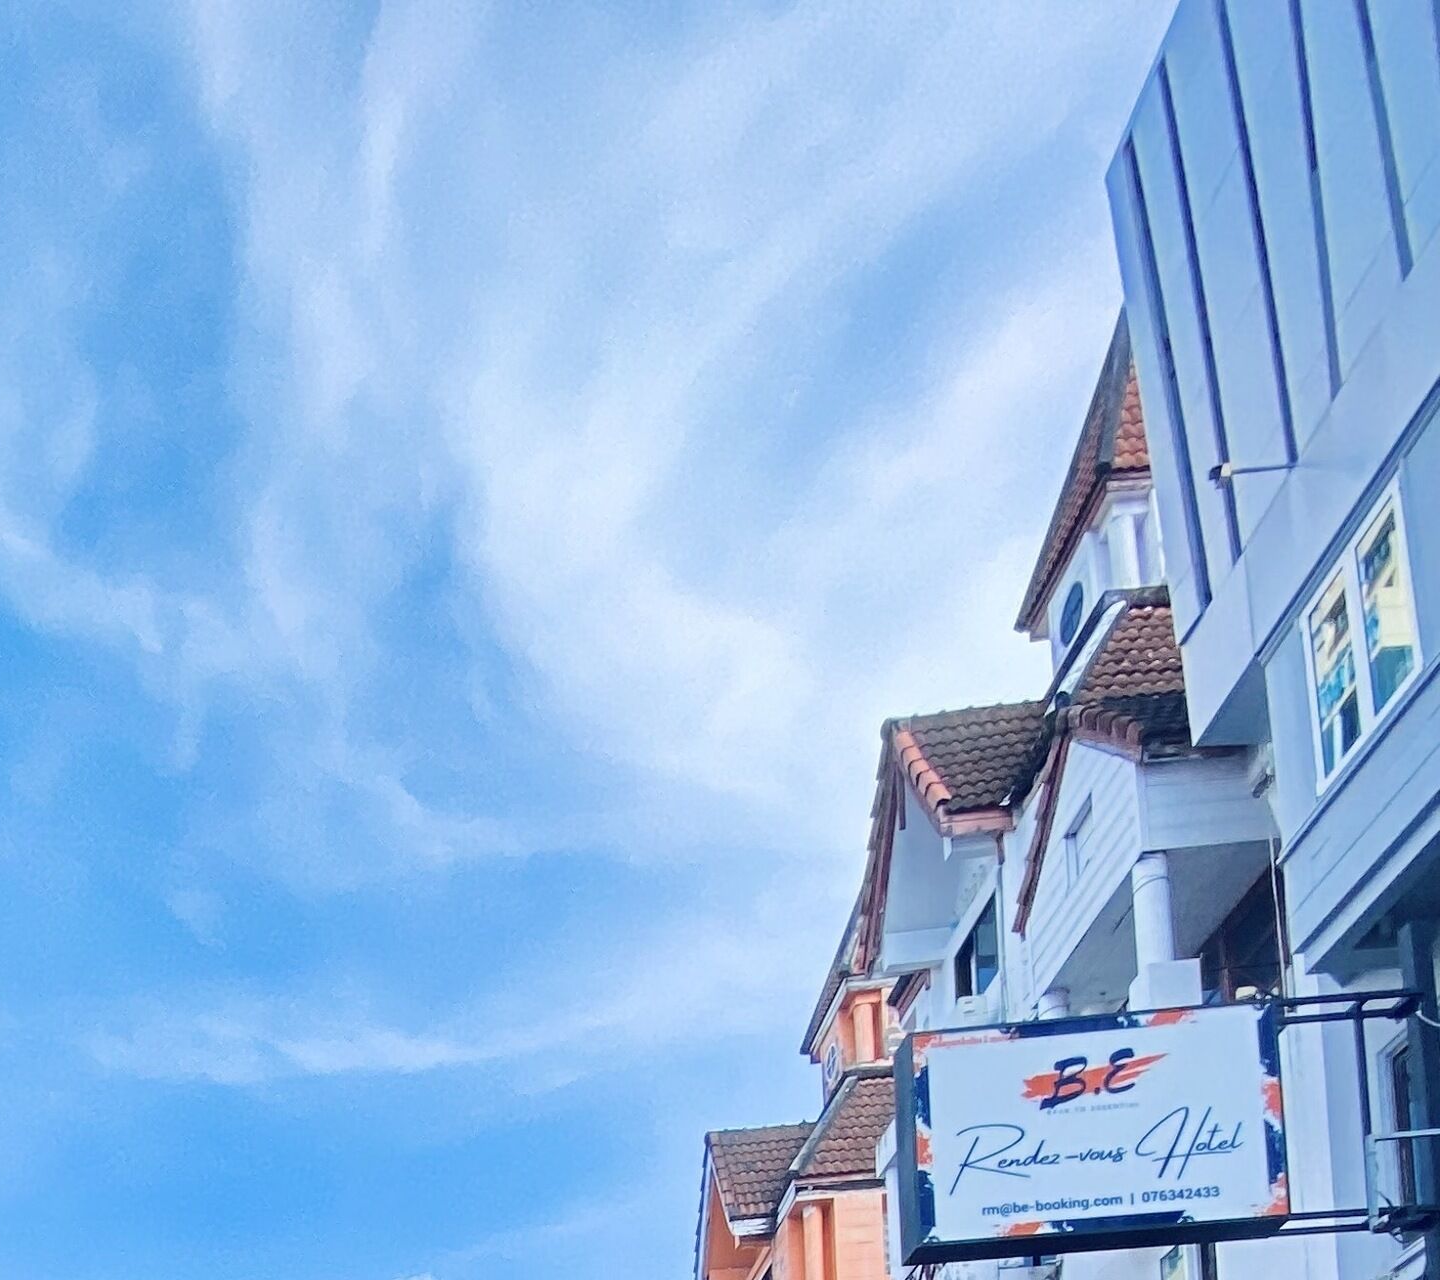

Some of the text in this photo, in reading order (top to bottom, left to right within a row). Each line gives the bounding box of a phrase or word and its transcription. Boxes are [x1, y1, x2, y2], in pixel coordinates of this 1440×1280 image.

[949, 1106, 1245, 1197] Rendez-vous Hotel
[981, 1185, 1220, 1217] rm@be-booking.com 076342433
